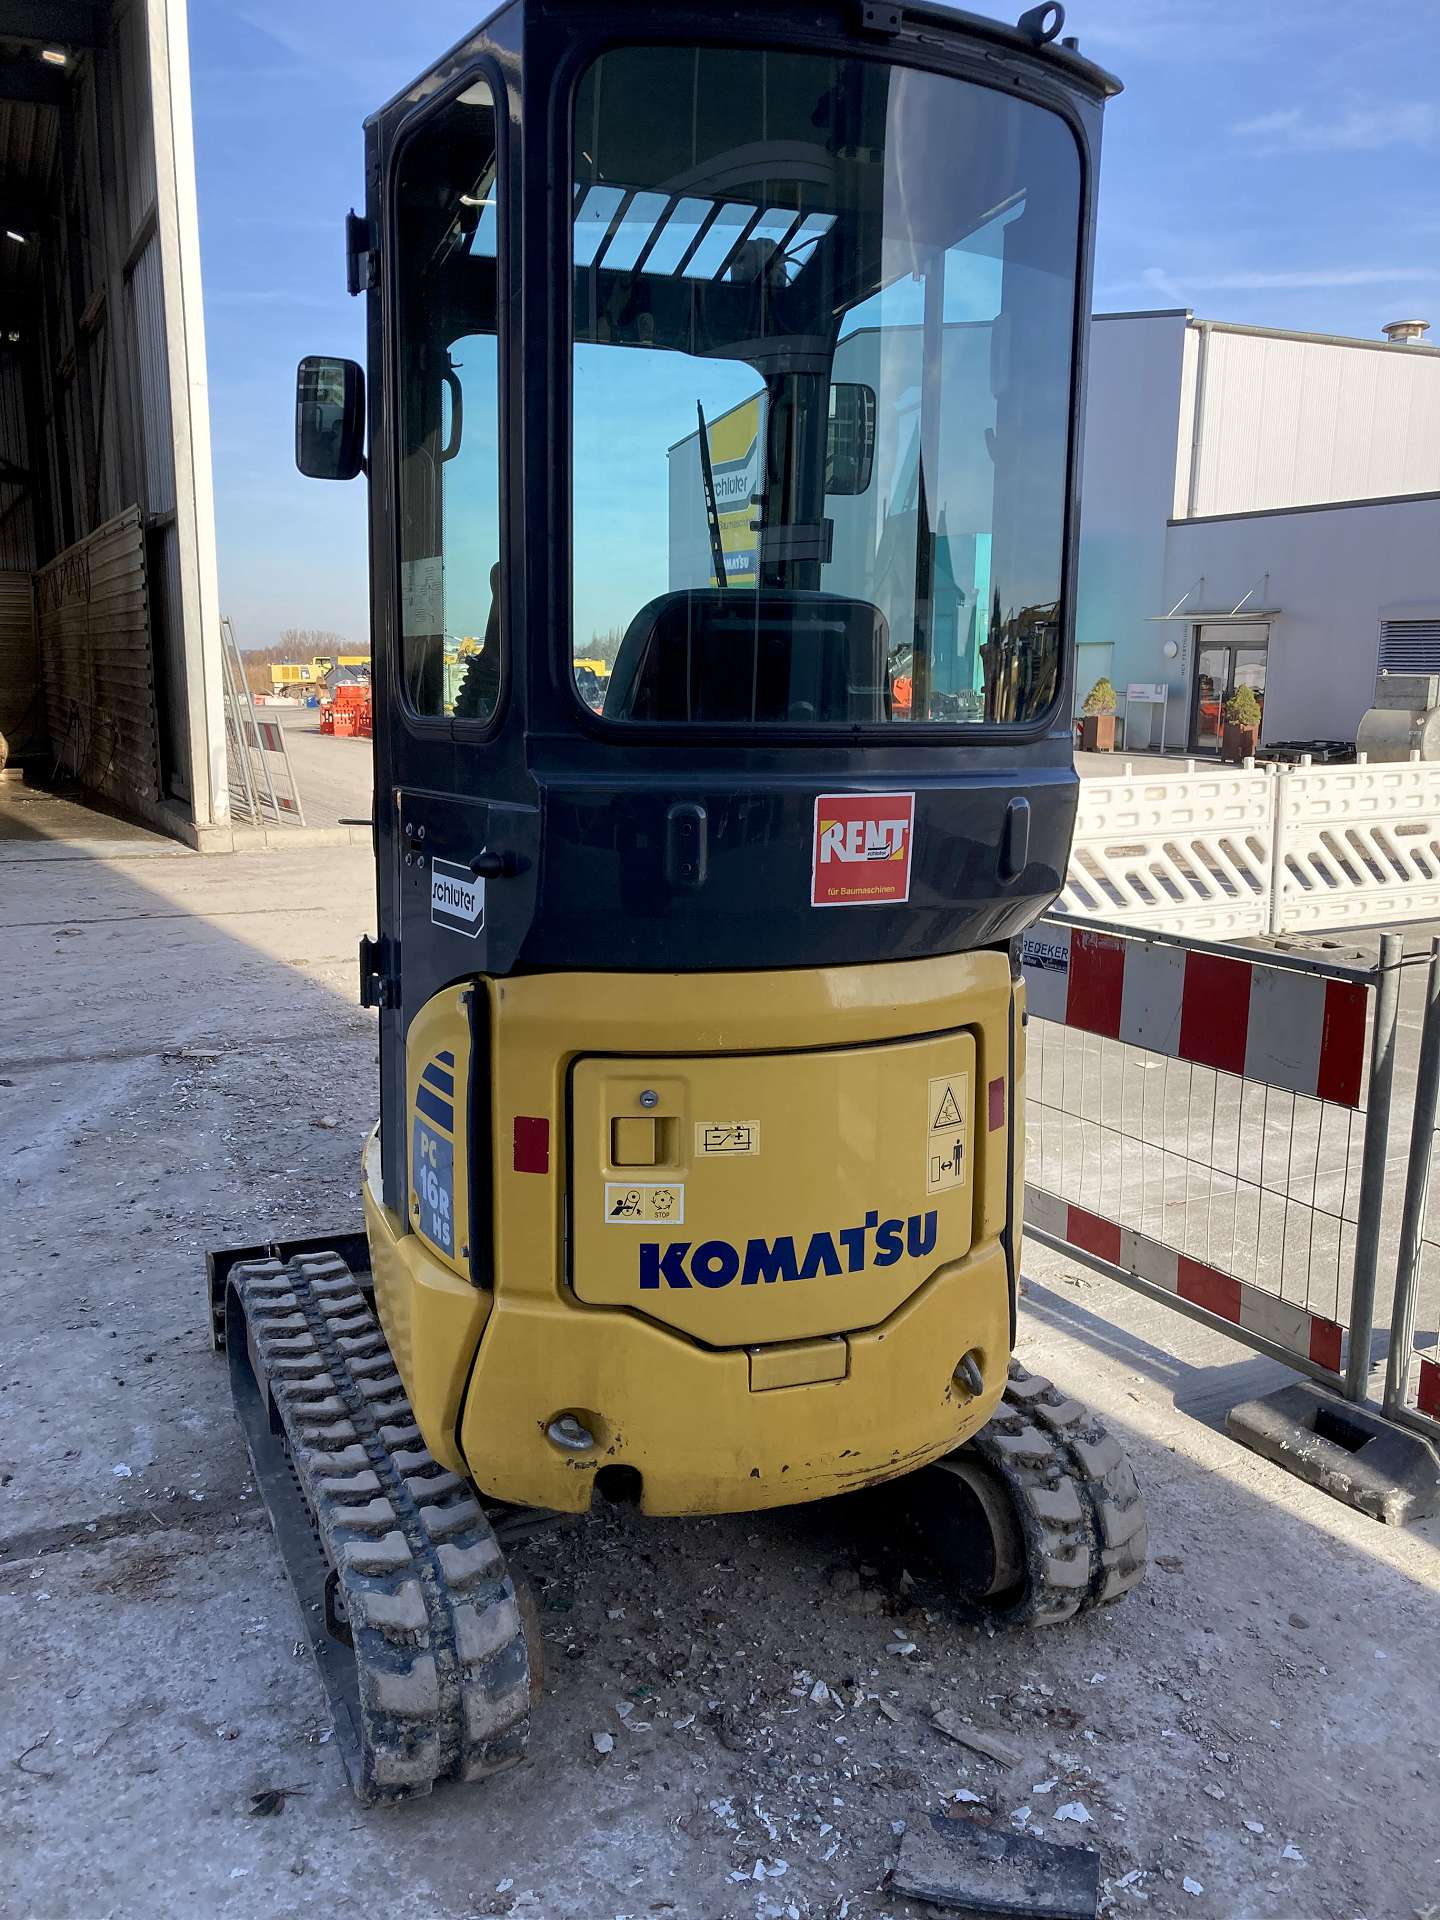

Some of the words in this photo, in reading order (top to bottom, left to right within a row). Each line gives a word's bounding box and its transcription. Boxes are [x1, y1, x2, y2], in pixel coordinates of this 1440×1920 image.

[724, 555, 749, 570] MATSU
[820, 820, 908, 863] RENT
[828, 887, 840, 896] für
[840, 885, 895, 895] Baumaschinen
[420, 1131, 437, 1168] PC
[420, 1164, 450, 1220] 16R
[432, 1213, 451, 1246] HS
[654, 1211, 670, 1219] STOP
[639, 1210, 938, 1290] KOMATSU
